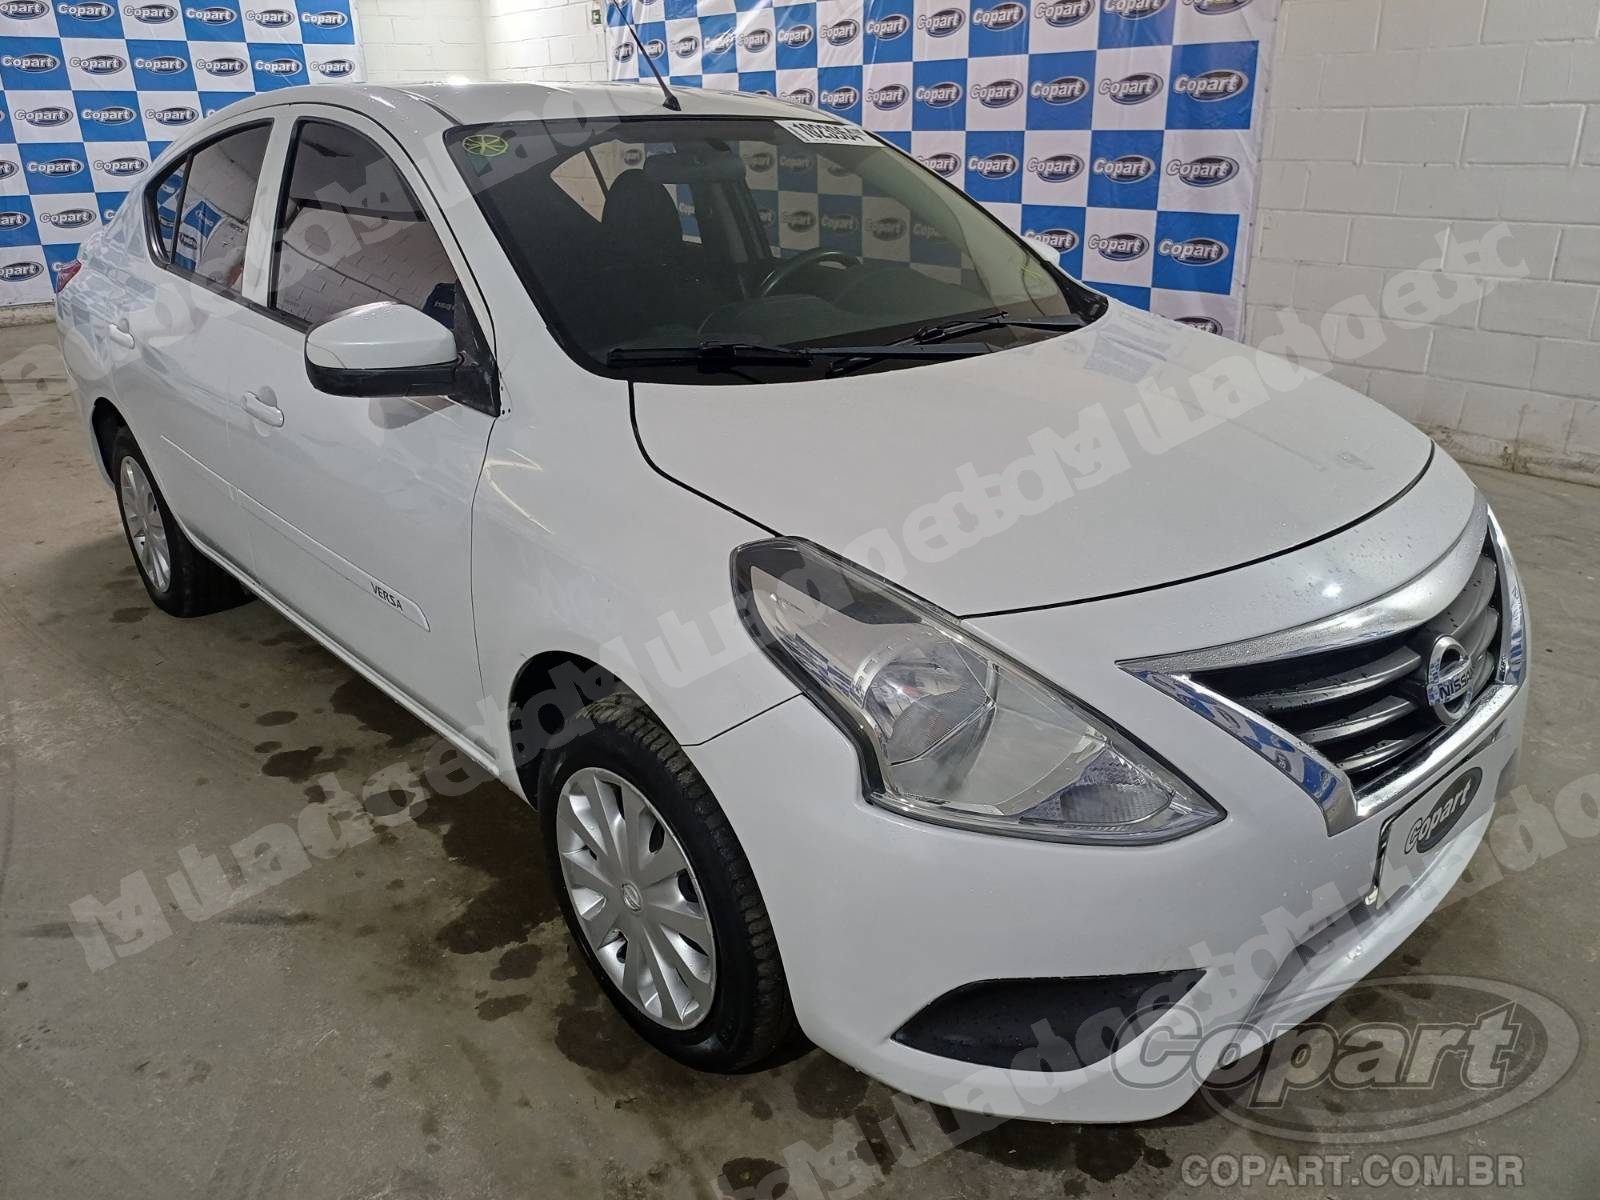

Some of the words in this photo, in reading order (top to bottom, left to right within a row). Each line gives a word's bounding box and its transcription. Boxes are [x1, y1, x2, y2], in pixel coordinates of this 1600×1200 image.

[0, 2, 41, 14] opart
[58, 4, 108, 17] Copart
[124, 5, 171, 19] Copart
[185, 8, 231, 22] Copart
[1034, 1, 1087, 20] Copart
[246, 10, 288, 23] Copart
[301, 12, 343, 25] Copart
[917, 14, 958, 32] Copart
[972, 7, 1020, 26] Copart
[821, 24, 855, 41] Copart
[867, 18, 904, 35] Copart
[777, 29, 811, 44] Copart
[2, 55, 53, 69] Copart
[69, 57, 119, 71] Copart
[135, 58, 183, 72] Copart
[196, 59, 241, 73] Copart
[255, 60, 298, 74] Copart
[309, 62, 350, 74] Copart
[971, 84, 1018, 102] Copart
[1030, 80, 1082, 99] Copart
[1098, 77, 1153, 97] Copart
[1174, 74, 1239, 97] Copart
[820, 90, 855, 106] Copart
[865, 89, 903, 107] Copart
[915, 86, 957, 103] Copart
[14, 110, 65, 124] Copart
[82, 108, 130, 122] Copart
[145, 108, 193, 122] Copart
[27, 161, 78, 175] Copart
[94, 159, 142, 173] Copart
[968, 155, 1014, 173] Copart
[1027, 156, 1075, 176] Copart
[1093, 156, 1147, 177] Copart
[1166, 158, 1229, 179] Copart
[0, 214, 22, 224] art
[40, 211, 90, 225] Copart
[1088, 234, 1142, 255] Copart
[1159, 238, 1219, 260] Copart
[0, 265, 35, 278] opart
[370, 581, 403, 611] VERSA
[1404, 778, 1472, 854] Copart
